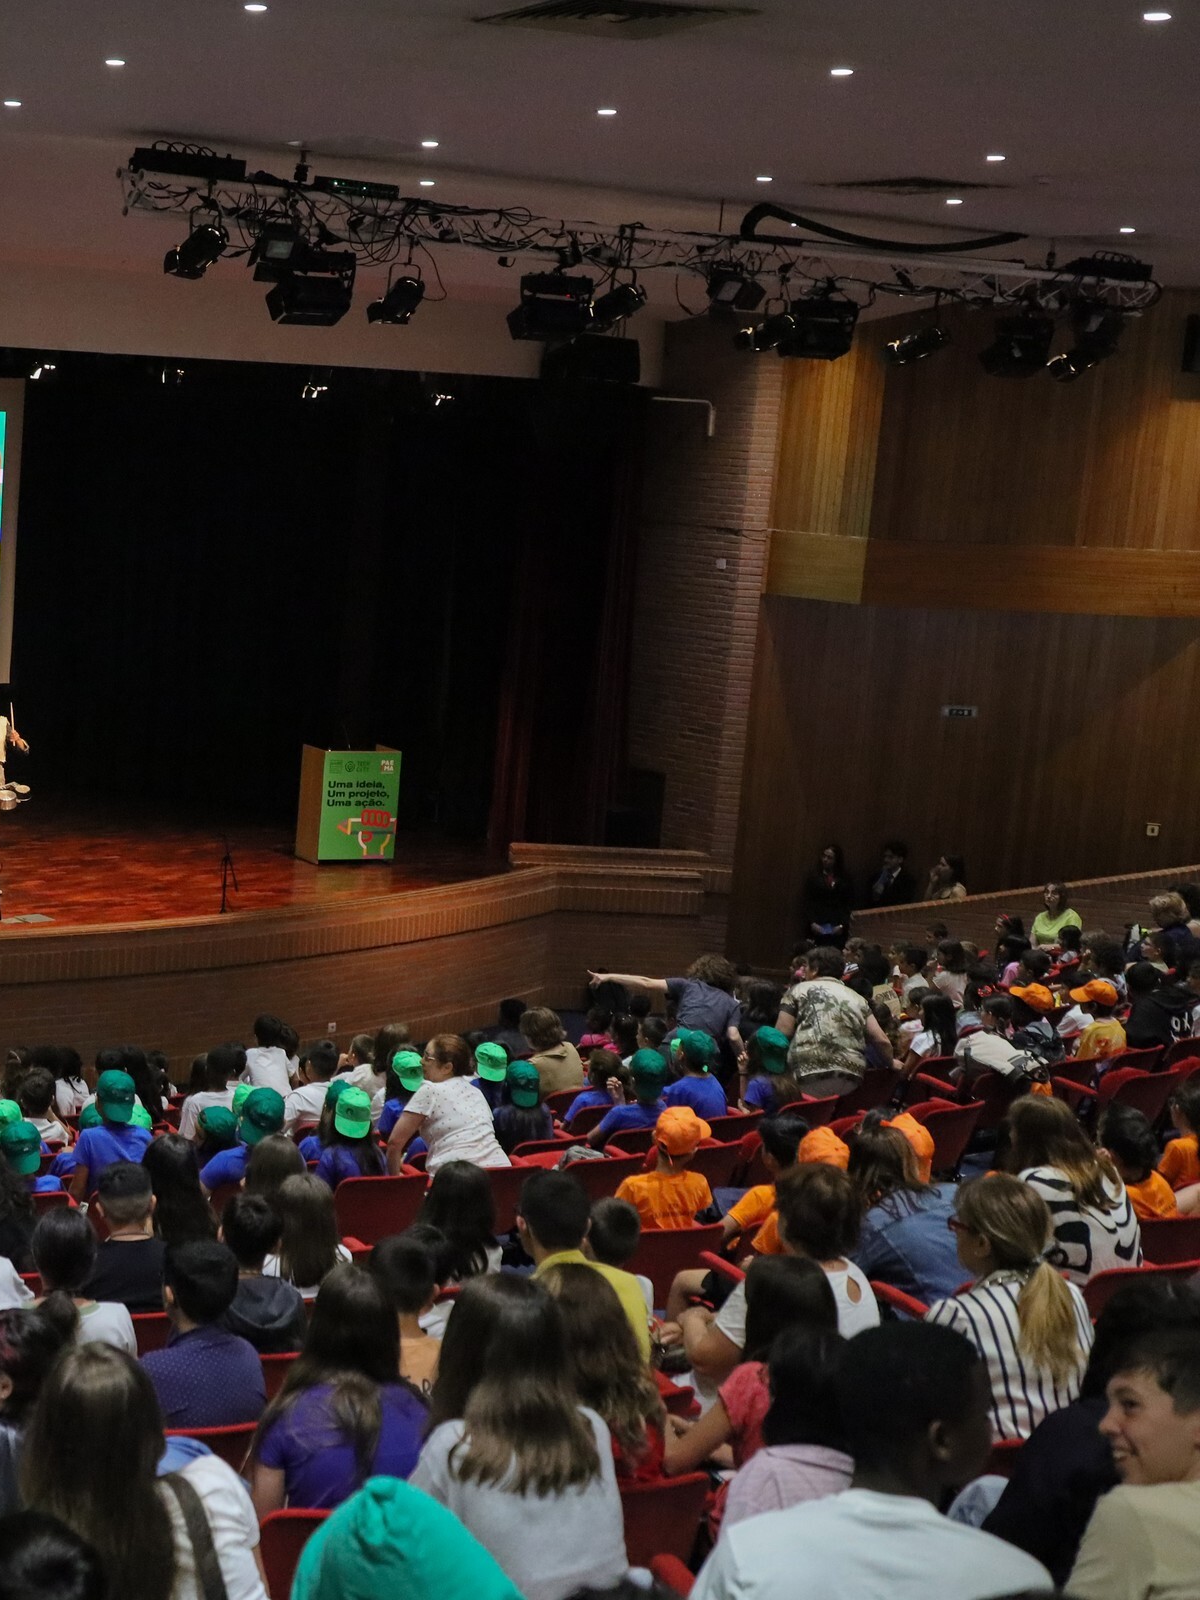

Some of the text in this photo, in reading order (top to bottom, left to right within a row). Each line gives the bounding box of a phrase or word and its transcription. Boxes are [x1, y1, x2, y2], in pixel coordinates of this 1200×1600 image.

[328, 781, 385, 789] Uma ideia,
[349, 790, 390, 799] projeto,
[355, 799, 385, 808] ação.
